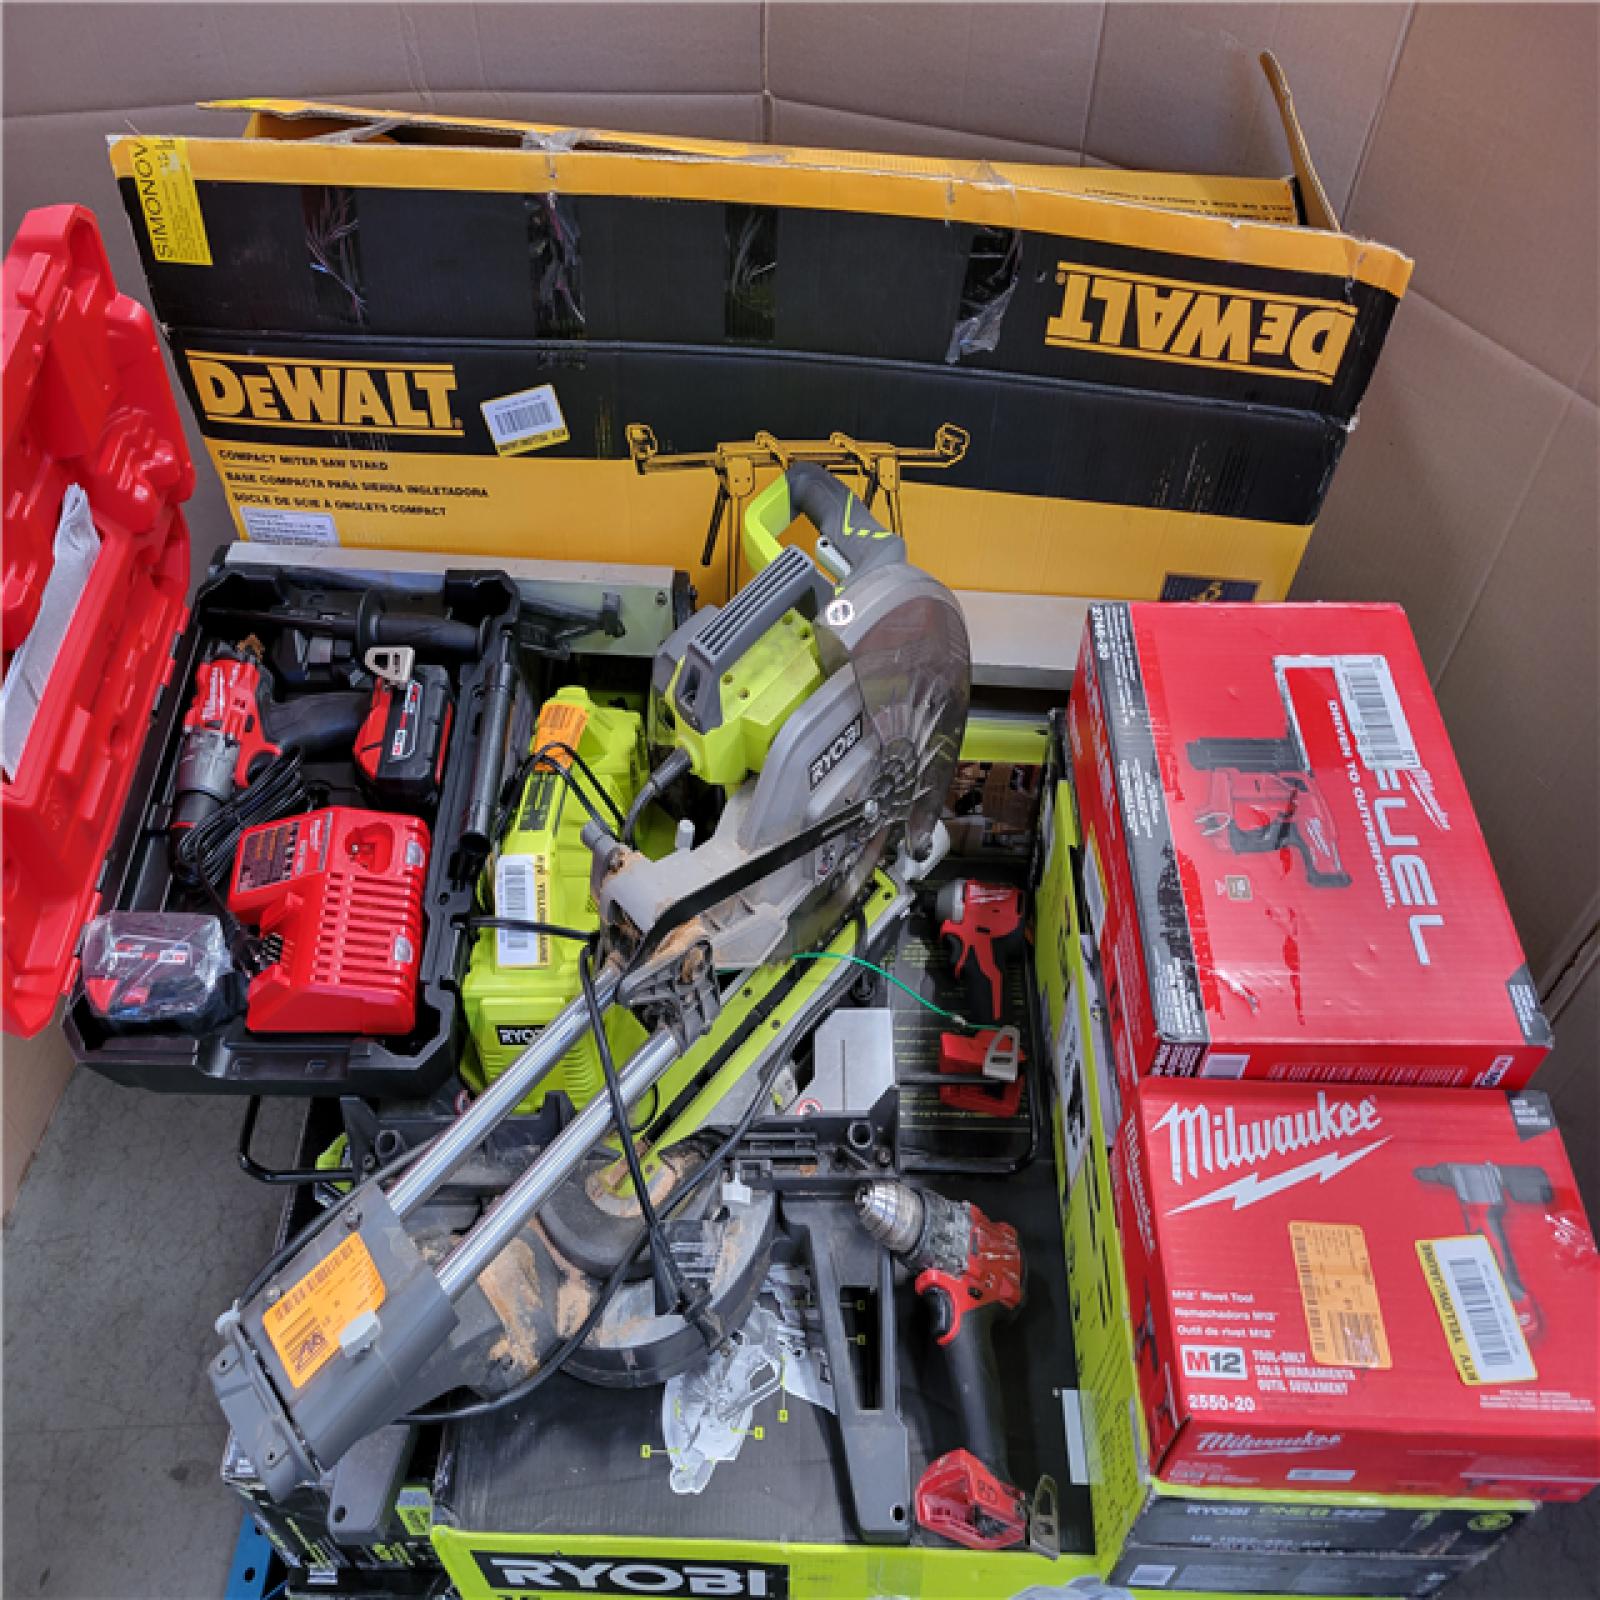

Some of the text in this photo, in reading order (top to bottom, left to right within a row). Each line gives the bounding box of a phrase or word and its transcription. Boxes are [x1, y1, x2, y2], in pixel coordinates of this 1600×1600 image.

[218, 449, 275, 463] COMPACT
[349, 459, 388, 470] STAND
[327, 479, 358, 490] PARA
[390, 504, 446, 516] COMPACT
[811, 720, 861, 783] RYOBI
[1328, 700, 1353, 758] DRIVEN
[1345, 760, 1361, 783] TO
[1150, 1091, 1383, 1185] Milwaukee
[1231, 1290, 1254, 1303] Tool
[1185, 1350, 1242, 1374] M12
[1187, 1394, 1256, 1414] 2550-20
[1196, 1429, 1344, 1451] Milwaukee
[490, 1559, 769, 1597] RYOBI
